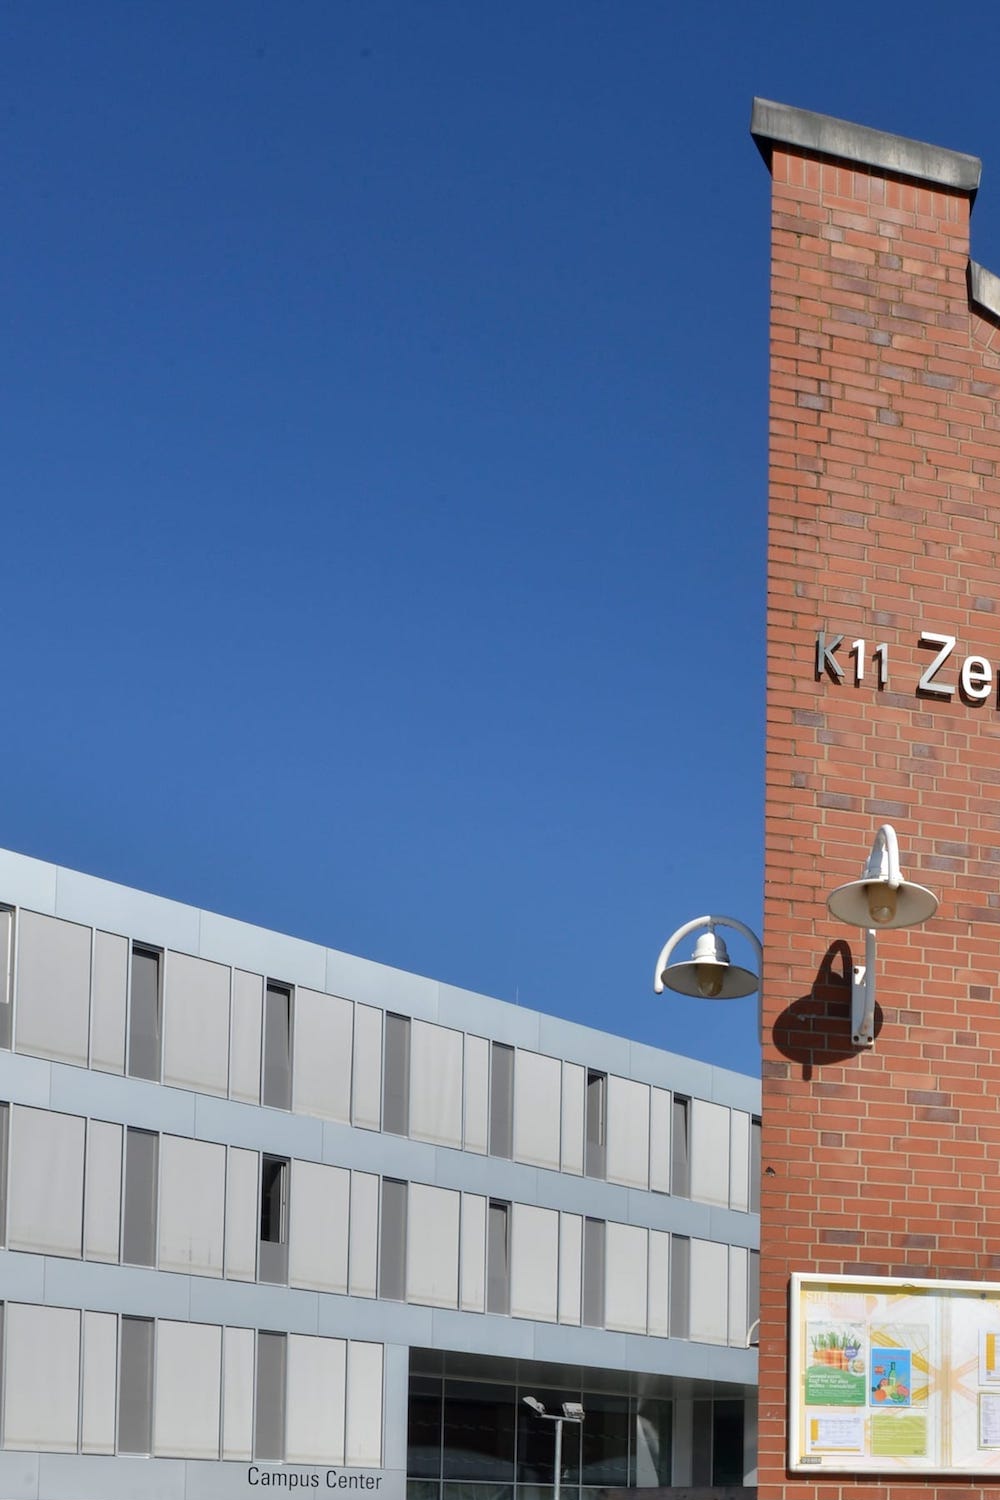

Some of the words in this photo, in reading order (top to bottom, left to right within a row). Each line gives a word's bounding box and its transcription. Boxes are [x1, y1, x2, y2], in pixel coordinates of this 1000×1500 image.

[816, 630, 888, 685] K11
[247, 1466, 320, 1491] Campus
[326, 1470, 383, 1490] Center
